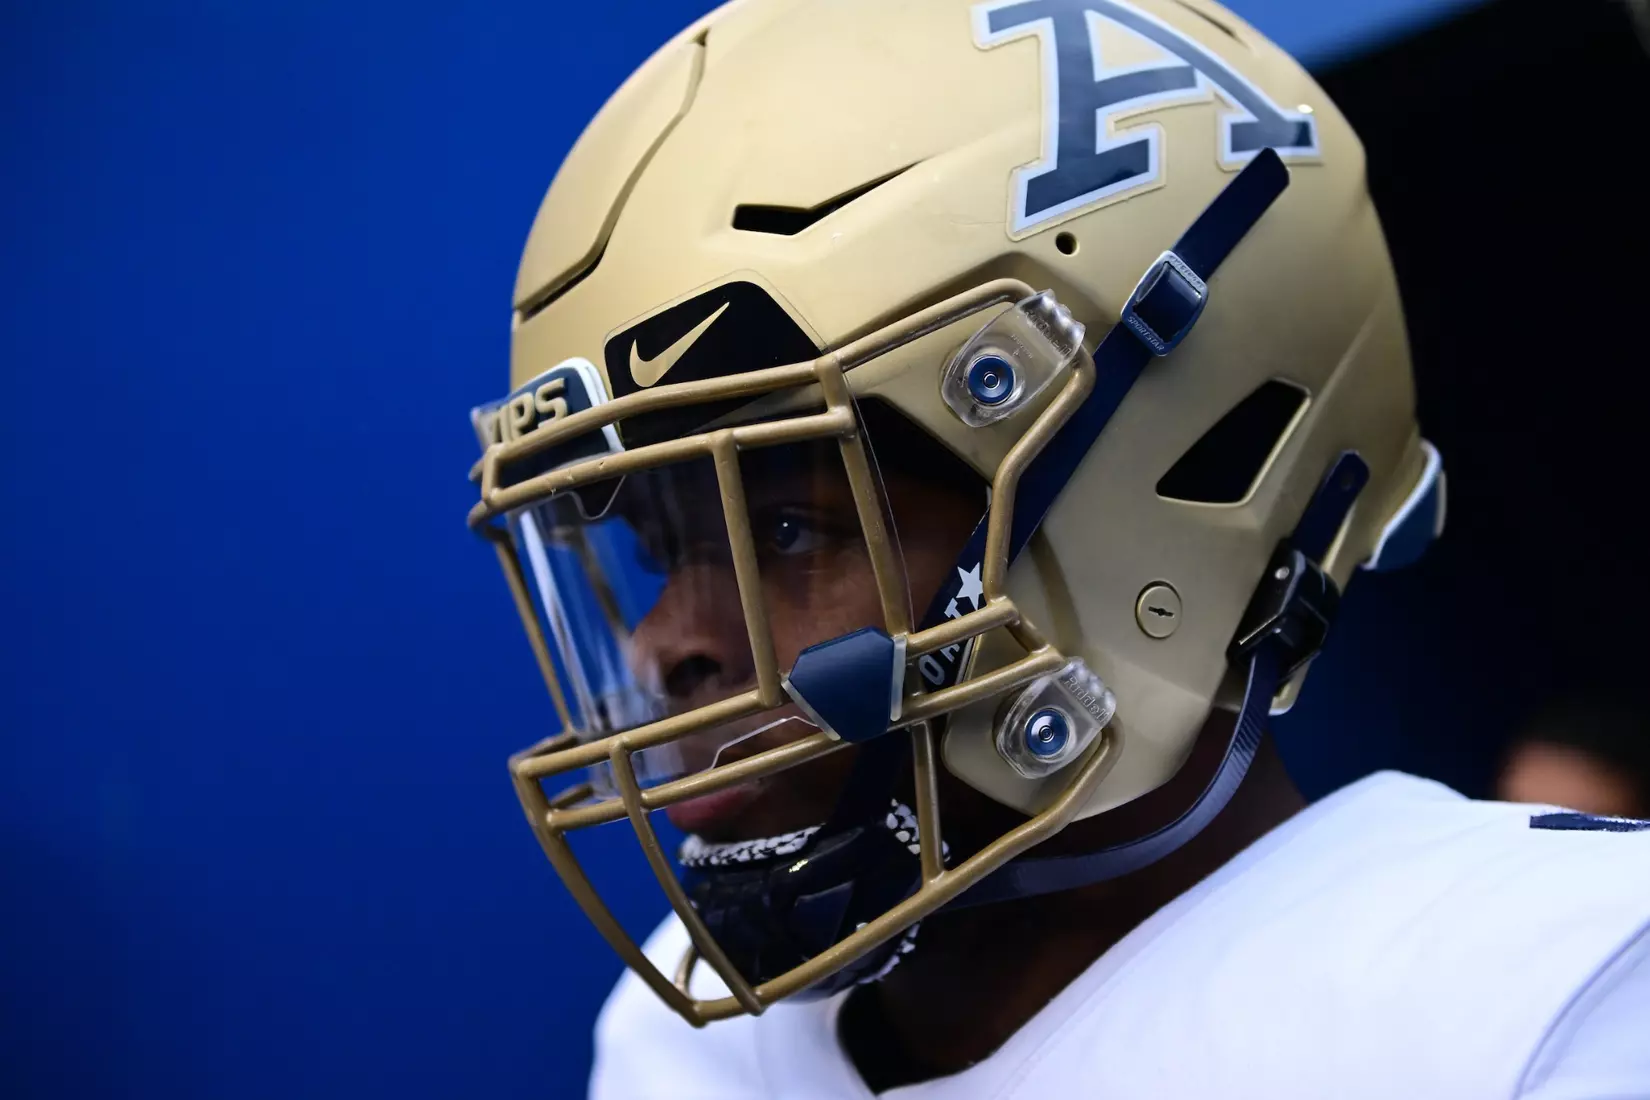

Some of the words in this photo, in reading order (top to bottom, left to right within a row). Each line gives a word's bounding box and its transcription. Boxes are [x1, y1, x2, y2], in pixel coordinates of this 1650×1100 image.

[972, 0, 1320, 236] A
[1127, 315, 1165, 351] SPORTSTAR
[1065, 675, 1111, 723] Riddell
